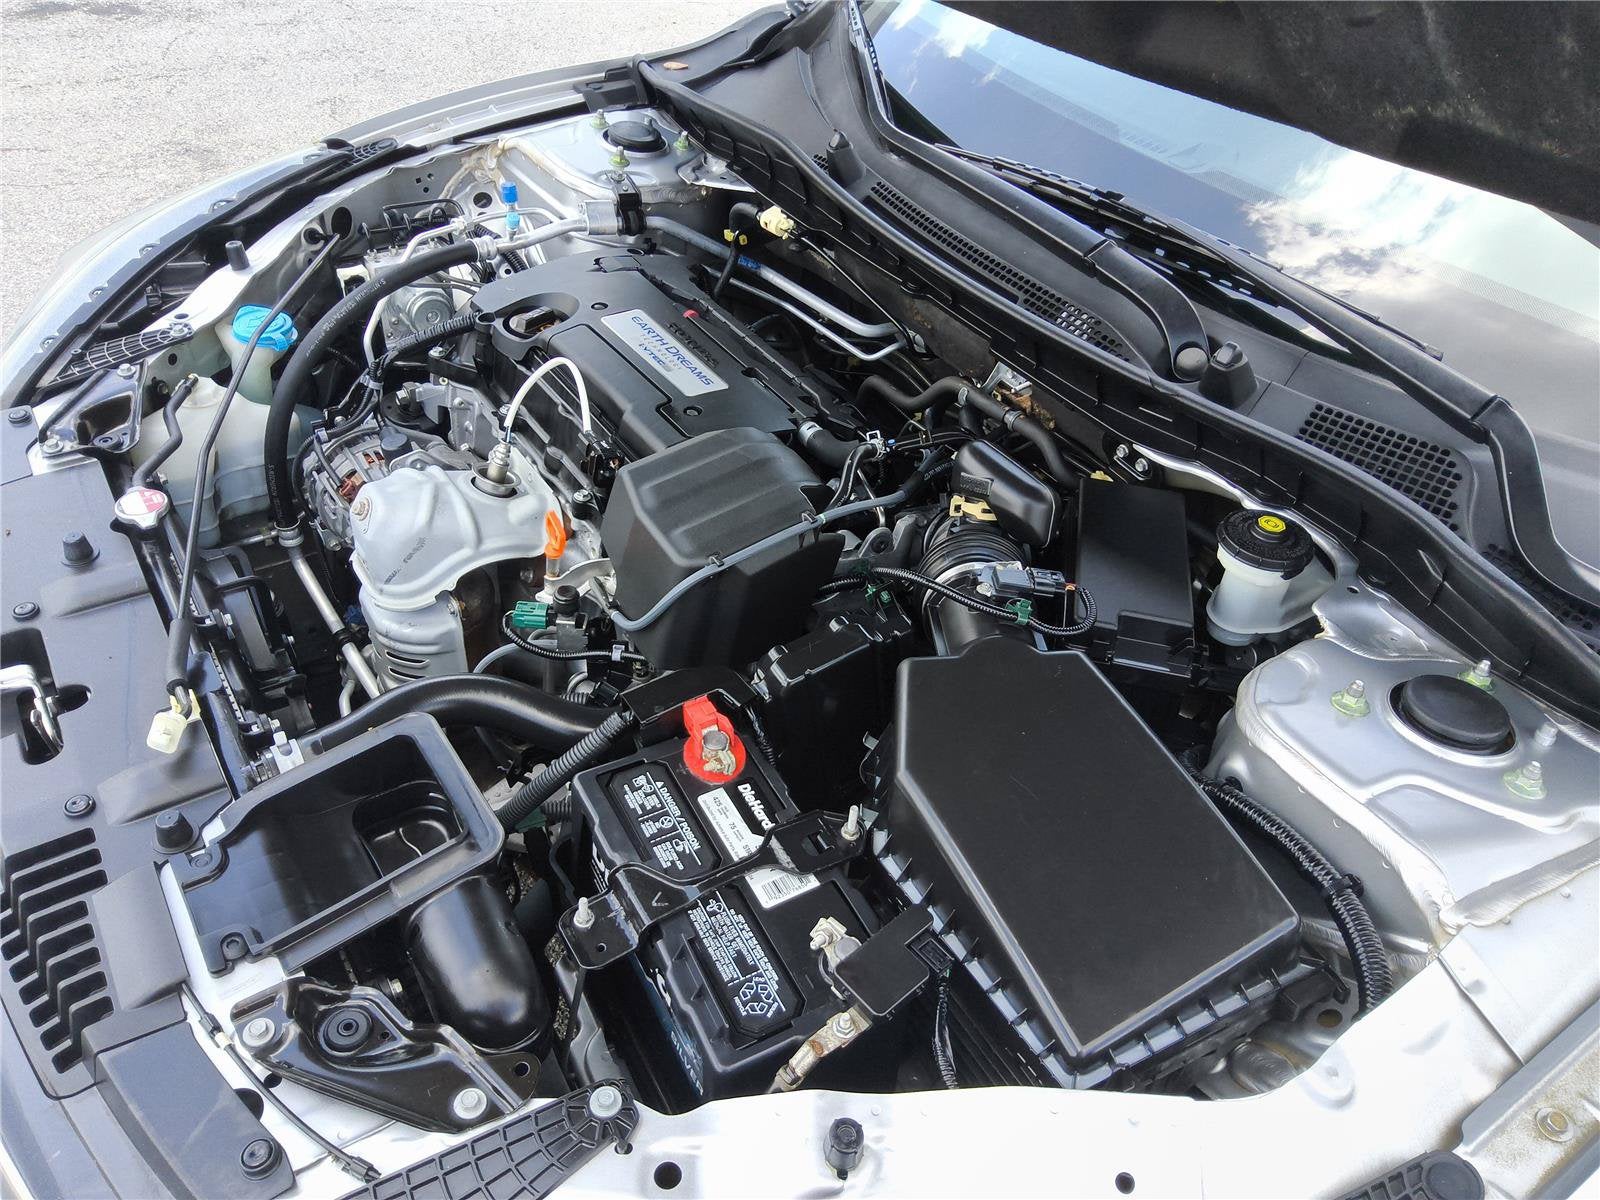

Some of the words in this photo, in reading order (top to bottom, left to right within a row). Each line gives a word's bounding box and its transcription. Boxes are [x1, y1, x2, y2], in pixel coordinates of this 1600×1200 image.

[632, 316, 668, 346] EARTH
[667, 345, 714, 386] DREAMS
[659, 787, 680, 816] DANGER
[679, 821, 700, 850] POISON
[712, 795, 722, 806] 425
[737, 783, 776, 831] DieHard
